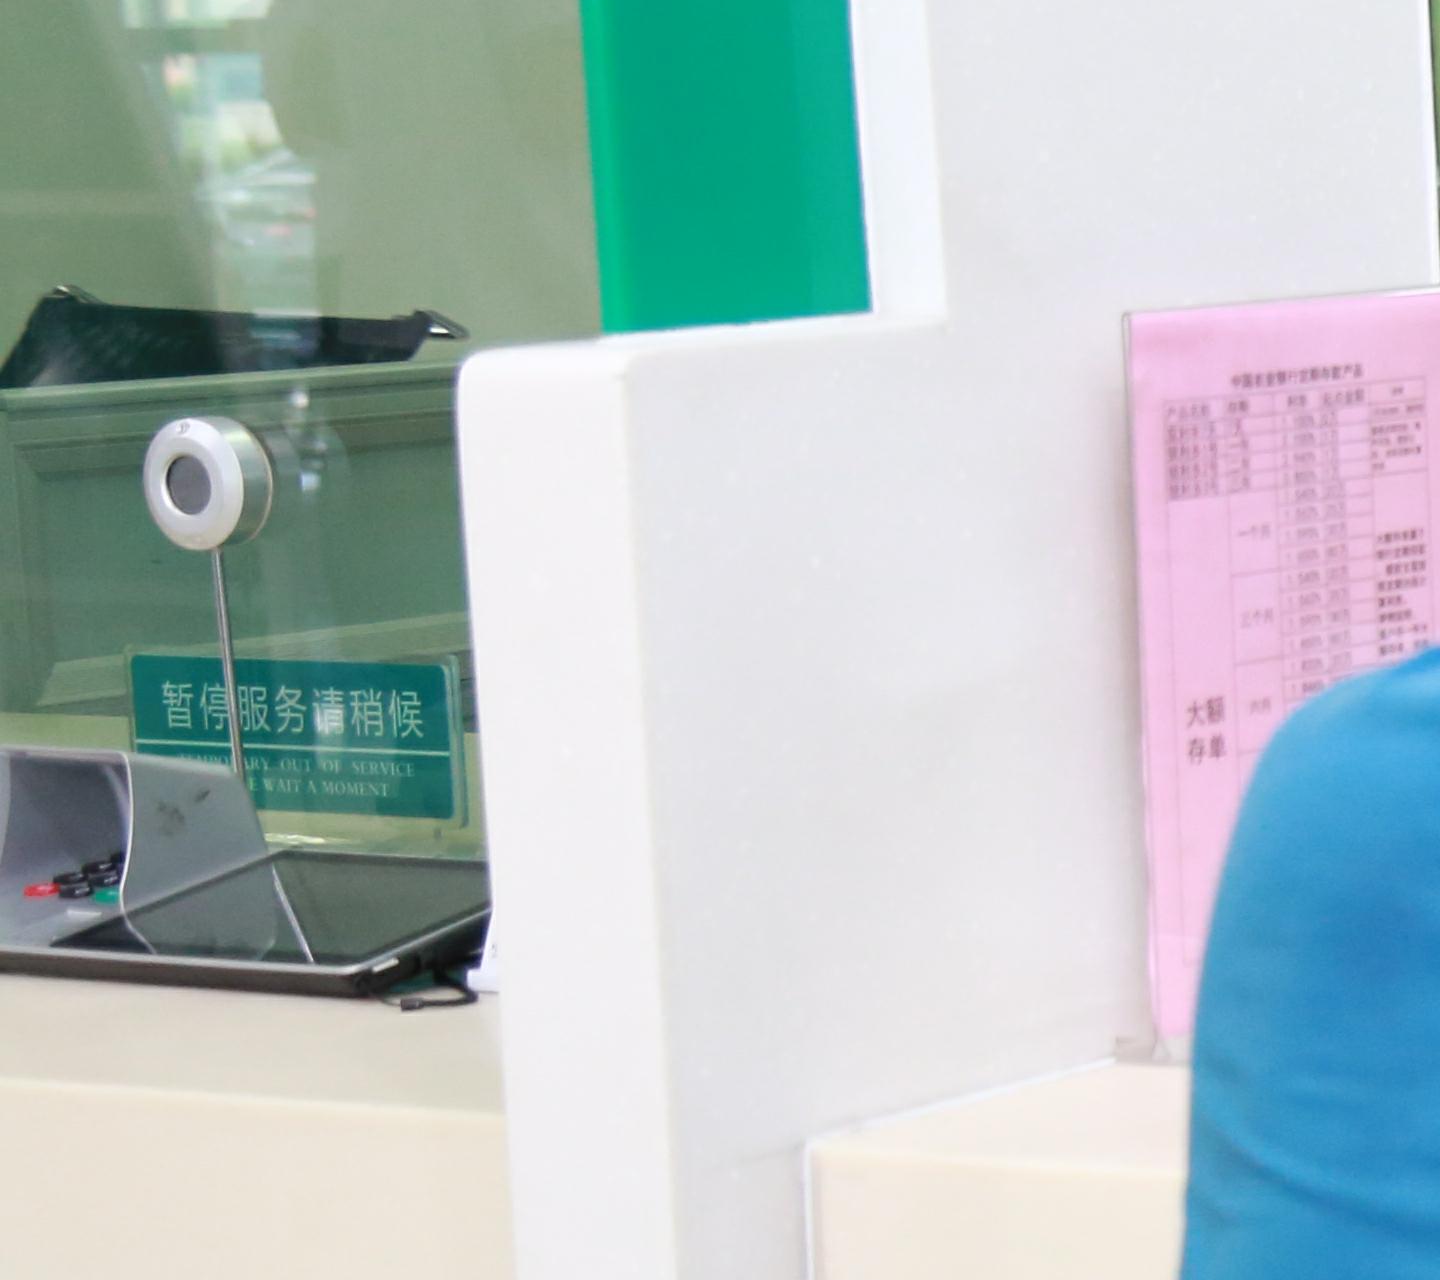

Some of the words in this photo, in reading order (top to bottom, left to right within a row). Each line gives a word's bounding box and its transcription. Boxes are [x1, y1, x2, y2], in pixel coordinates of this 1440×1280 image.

[161, 680, 425, 739] 暂停服务请稍候
[279, 758, 311, 773] OUT
[352, 761, 416, 778] SERVICE
[263, 778, 301, 795] WAIT
[306, 780, 317, 794] A
[321, 780, 391, 797] MOMENT
